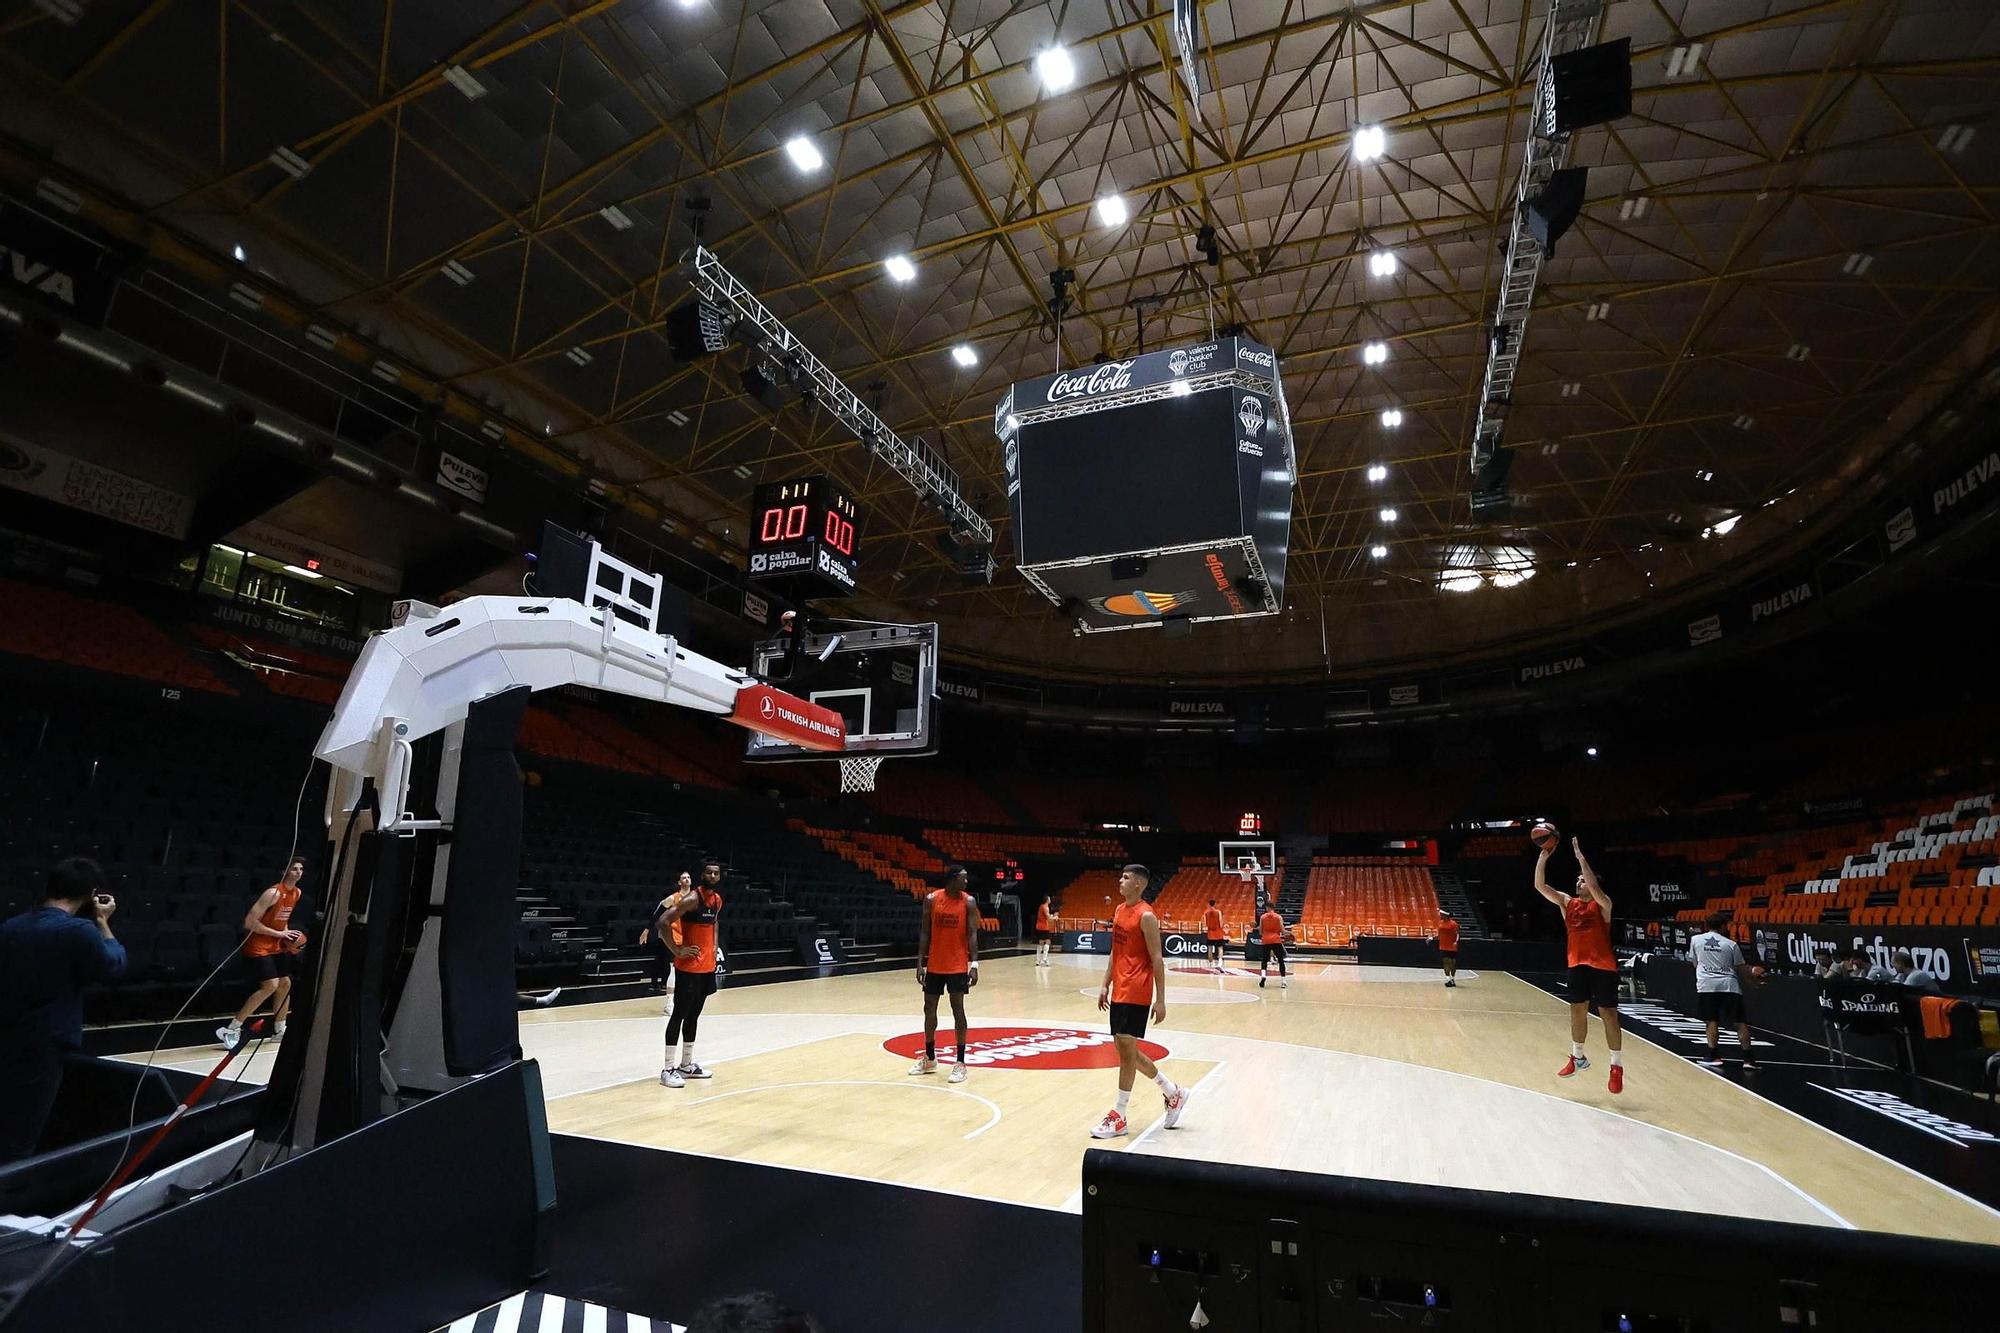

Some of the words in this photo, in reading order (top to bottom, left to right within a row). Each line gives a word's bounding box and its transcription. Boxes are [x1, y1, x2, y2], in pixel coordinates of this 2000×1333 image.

[0, 247, 75, 305] VA
[1189, 352, 1213, 363] basket
[1189, 361, 1206, 370] club
[1046, 359, 1136, 402] Coca-Cola
[443, 457, 485, 484] PULEVA
[1933, 451, 2000, 516] PULEVA
[768, 550, 797, 562] caixa
[768, 557, 812, 570] popular
[830, 559, 848, 575] caixa
[829, 566, 856, 588] popular
[1752, 583, 1813, 623] PULEVA
[213, 606, 261, 628] JUNTS
[266, 618, 299, 639] SOM
[1521, 655, 1586, 683] PULEVA
[161, 687, 181, 700] 125
[1171, 702, 1225, 713] PULEVA
[777, 706, 809, 728] TURKISH
[809, 720, 840, 738] AIRLINES
[1841, 999, 1900, 1013] SPALDING
